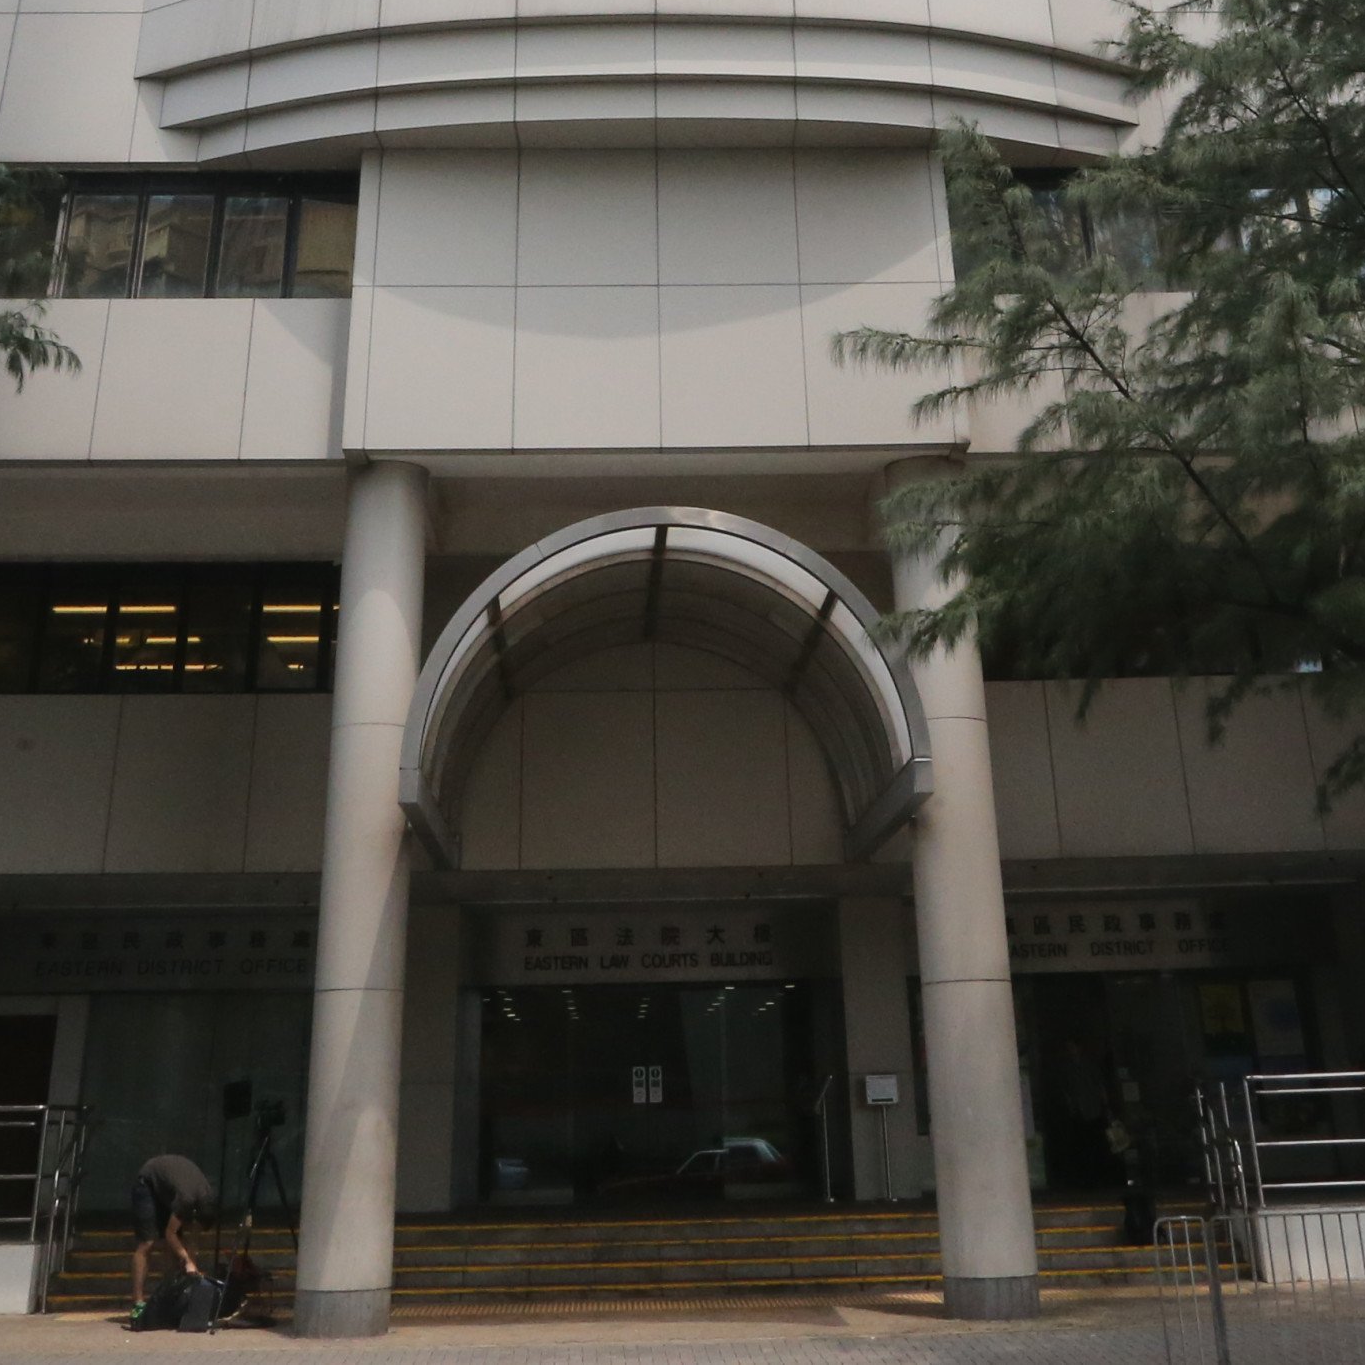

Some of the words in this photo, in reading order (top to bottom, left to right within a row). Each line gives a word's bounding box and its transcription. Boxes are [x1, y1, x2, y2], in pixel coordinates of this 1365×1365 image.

[1011, 942, 1067, 959] ASTERN
[1090, 939, 1154, 956] DISTRICT
[35, 959, 123, 977] EASTERN
[137, 958, 225, 976] DISTRICT
[239, 957, 308, 975] OFFICE
[524, 955, 589, 971] EASTERN
[600, 954, 630, 970] LAW
[641, 952, 699, 969] COURTS
[710, 950, 773, 967] BUILDING
